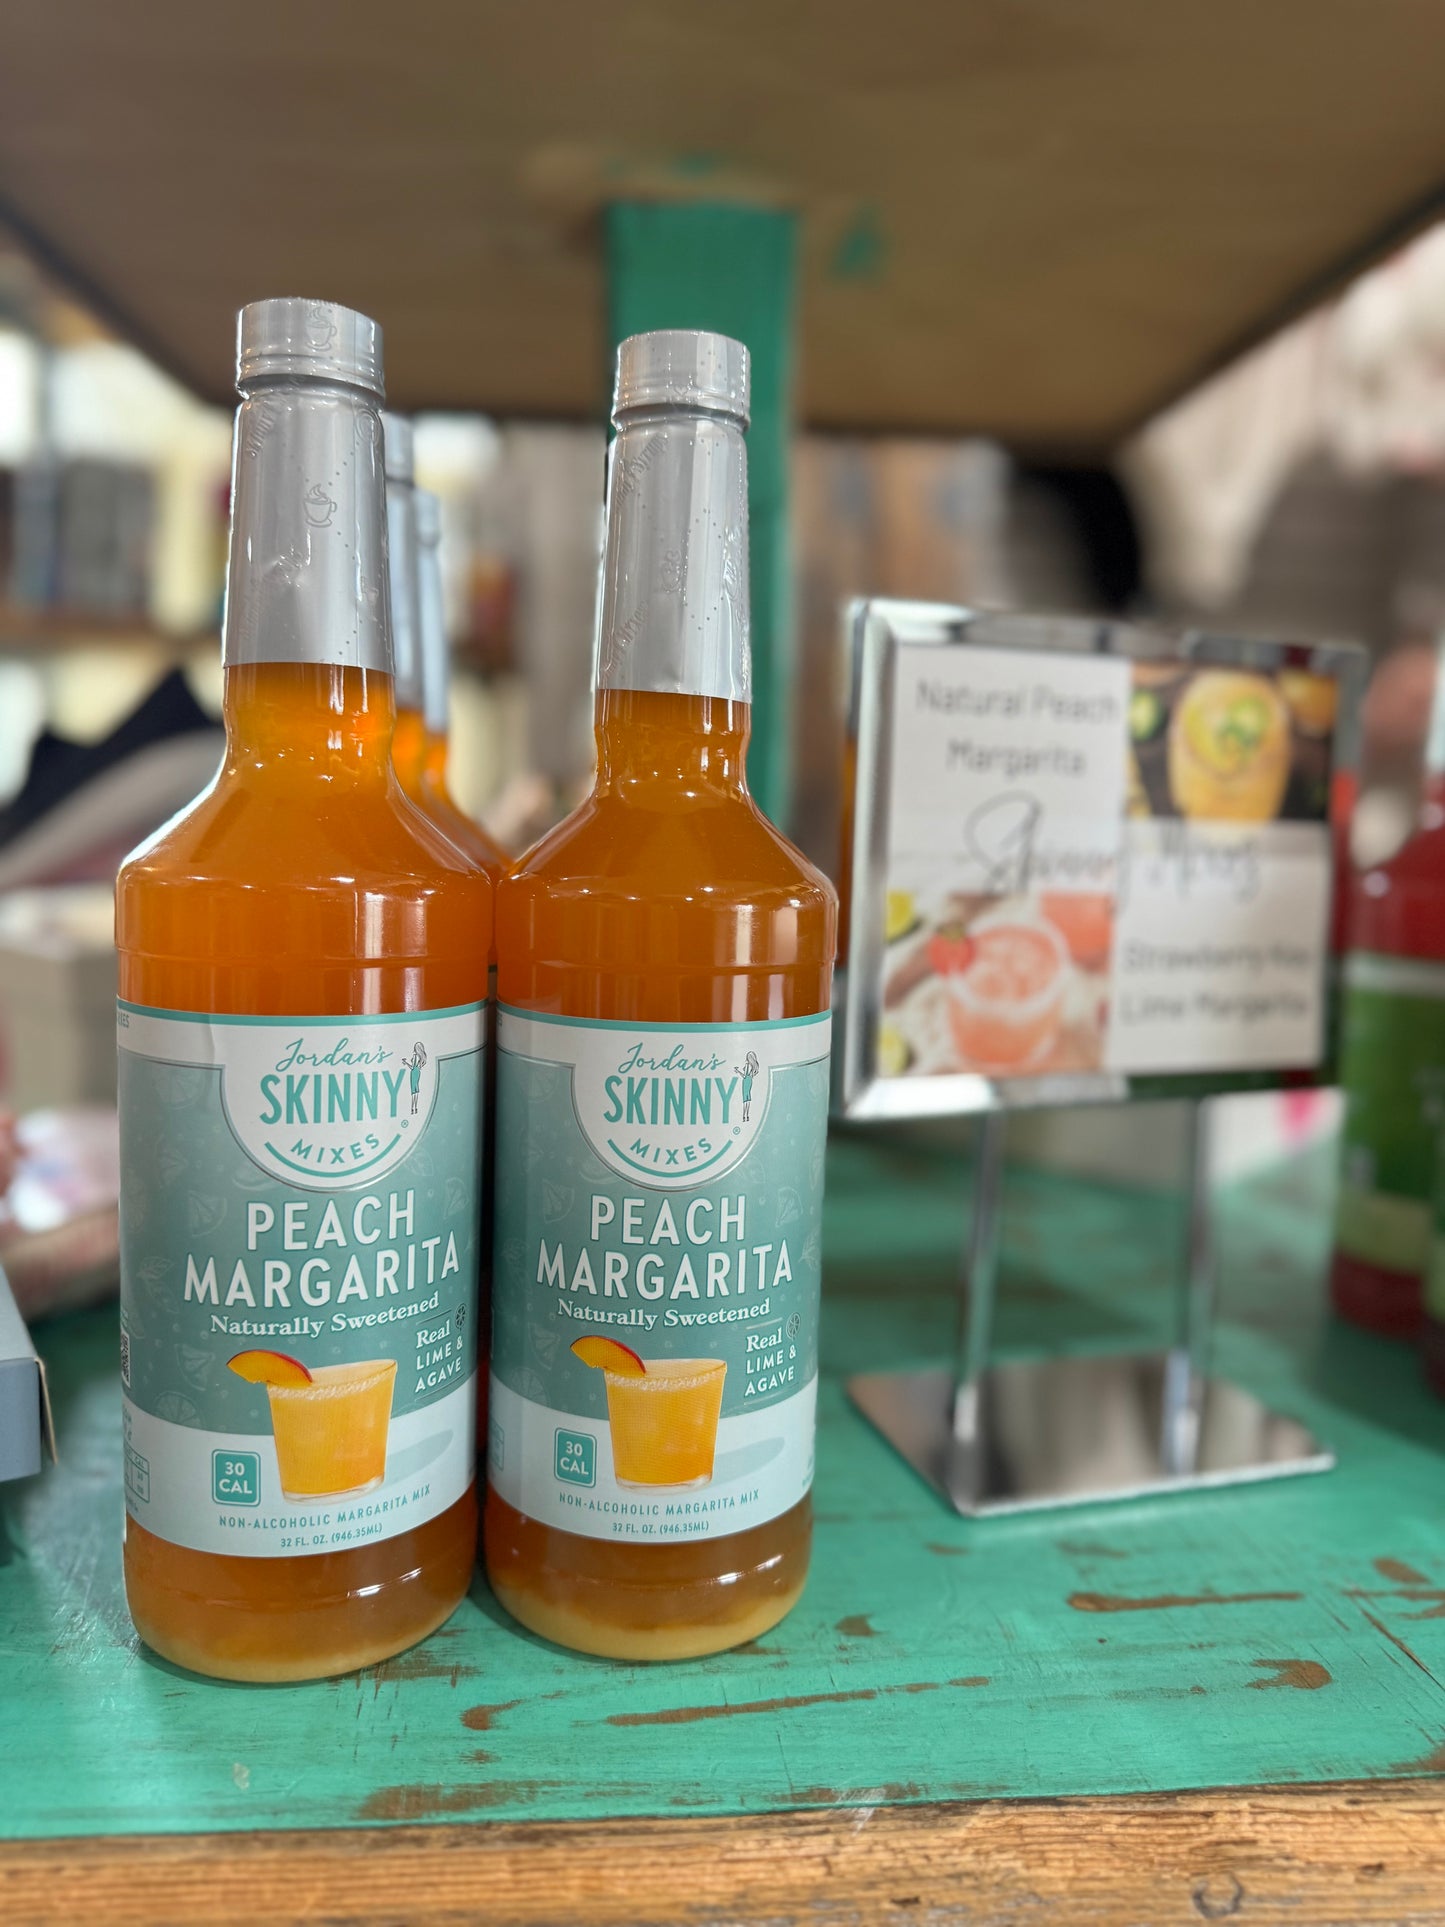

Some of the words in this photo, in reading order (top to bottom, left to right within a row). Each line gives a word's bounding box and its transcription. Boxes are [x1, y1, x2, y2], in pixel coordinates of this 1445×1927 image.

[276, 1038, 393, 1072] Jordan's
[618, 1043, 727, 1073] Jordan's
[260, 1069, 406, 1125] SKINNY
[603, 1076, 738, 1125] SKINNY
[291, 1133, 380, 1164] MIXES
[630, 1138, 712, 1165] MIXES
[248, 1189, 415, 1251] PEACH
[591, 1195, 746, 1245] PEACH
[184, 1231, 460, 1307] MARGARITA
[537, 1239, 792, 1300] MARGARITA
[210, 1314, 331, 1338] Naturally
[331, 1292, 439, 1332] Sweetened
[558, 1299, 658, 1330] Naturally
[664, 1298, 770, 1328] Sweetened
[416, 1321, 450, 1349] Real
[746, 1329, 782, 1353] Real
[416, 1342, 452, 1370] LIME
[456, 1336, 464, 1349] &
[746, 1350, 784, 1375] LIME
[789, 1345, 796, 1359] &
[414, 1357, 463, 1393] AGAVE
[744, 1369, 795, 1397] AGAVE
[565, 1441, 583, 1456] 30
[225, 1461, 245, 1476] 30
[560, 1457, 589, 1476] CAL
[219, 1479, 252, 1495] CAL
[219, 1514, 331, 1529] NON-ALCOHOLIC
[337, 1497, 409, 1523] MARGARITA
[412, 1484, 431, 1503] MIX
[559, 1492, 660, 1515] NON-ALCOHOLIC
[666, 1498, 735, 1515] MARGARITA
[740, 1490, 759, 1506] MIX
[280, 1537, 292, 1548] 32
[296, 1536, 310, 1548] FL.
[313, 1533, 328, 1545] OZ.
[331, 1523, 383, 1543] (946.35ML)
[612, 1522, 623, 1532] 32
[625, 1522, 639, 1533] FL.
[643, 1521, 657, 1533] OZ.
[660, 1520, 709, 1535] (946.35ML)
